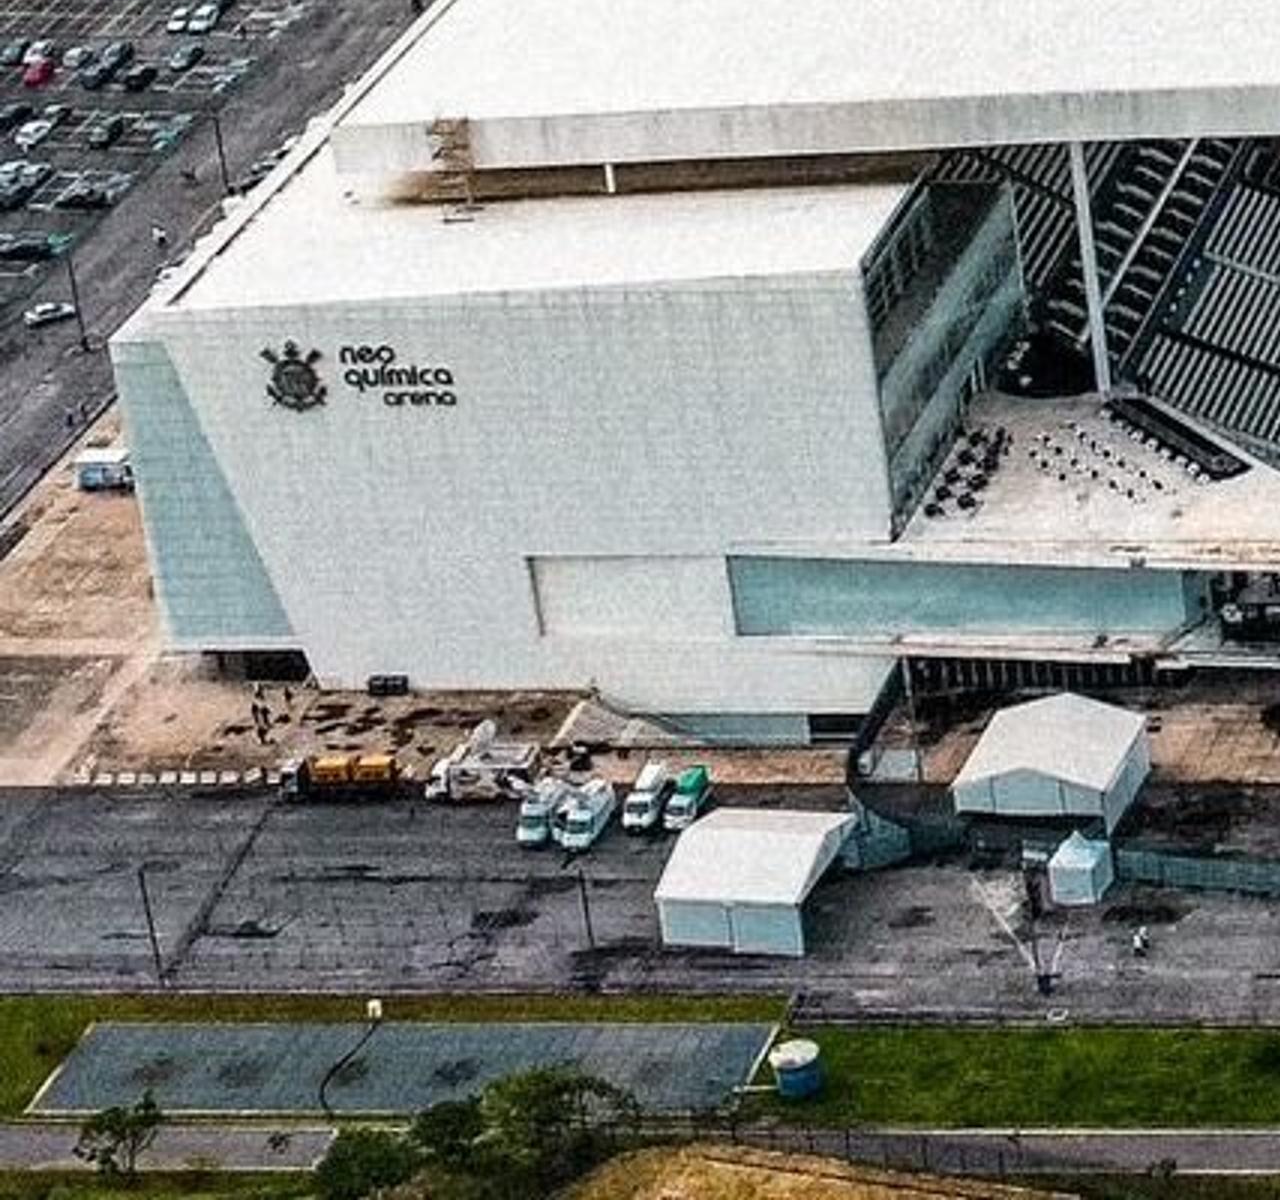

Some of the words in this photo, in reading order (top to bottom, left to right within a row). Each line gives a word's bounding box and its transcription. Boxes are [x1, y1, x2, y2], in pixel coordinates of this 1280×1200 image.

[339, 345, 396, 365] neo
[343, 365, 454, 393] química
[383, 390, 458, 406] arena
